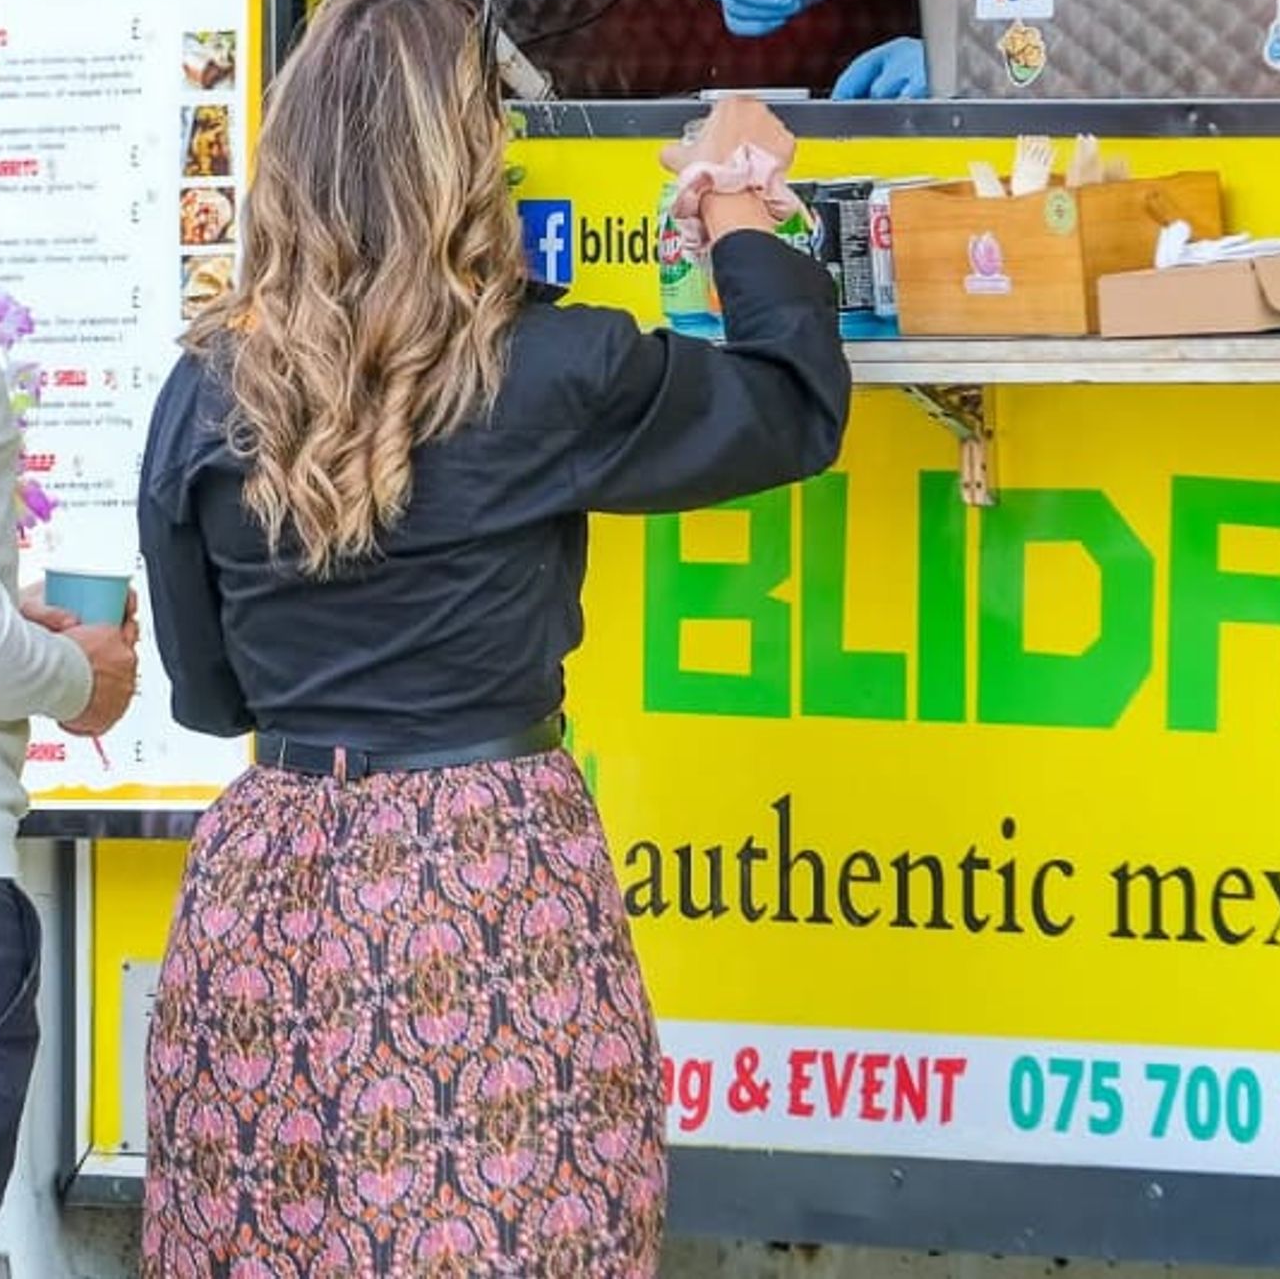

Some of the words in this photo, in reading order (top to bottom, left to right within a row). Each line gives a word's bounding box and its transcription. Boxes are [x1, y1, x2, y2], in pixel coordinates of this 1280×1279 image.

[580, 216, 661, 265] blid
[624, 793, 1075, 938] authentic
[726, 1046, 772, 1114] &
[787, 1048, 967, 1126] EVENT
[1009, 1054, 1125, 1136] 075
[1144, 1062, 1262, 1144] 700
